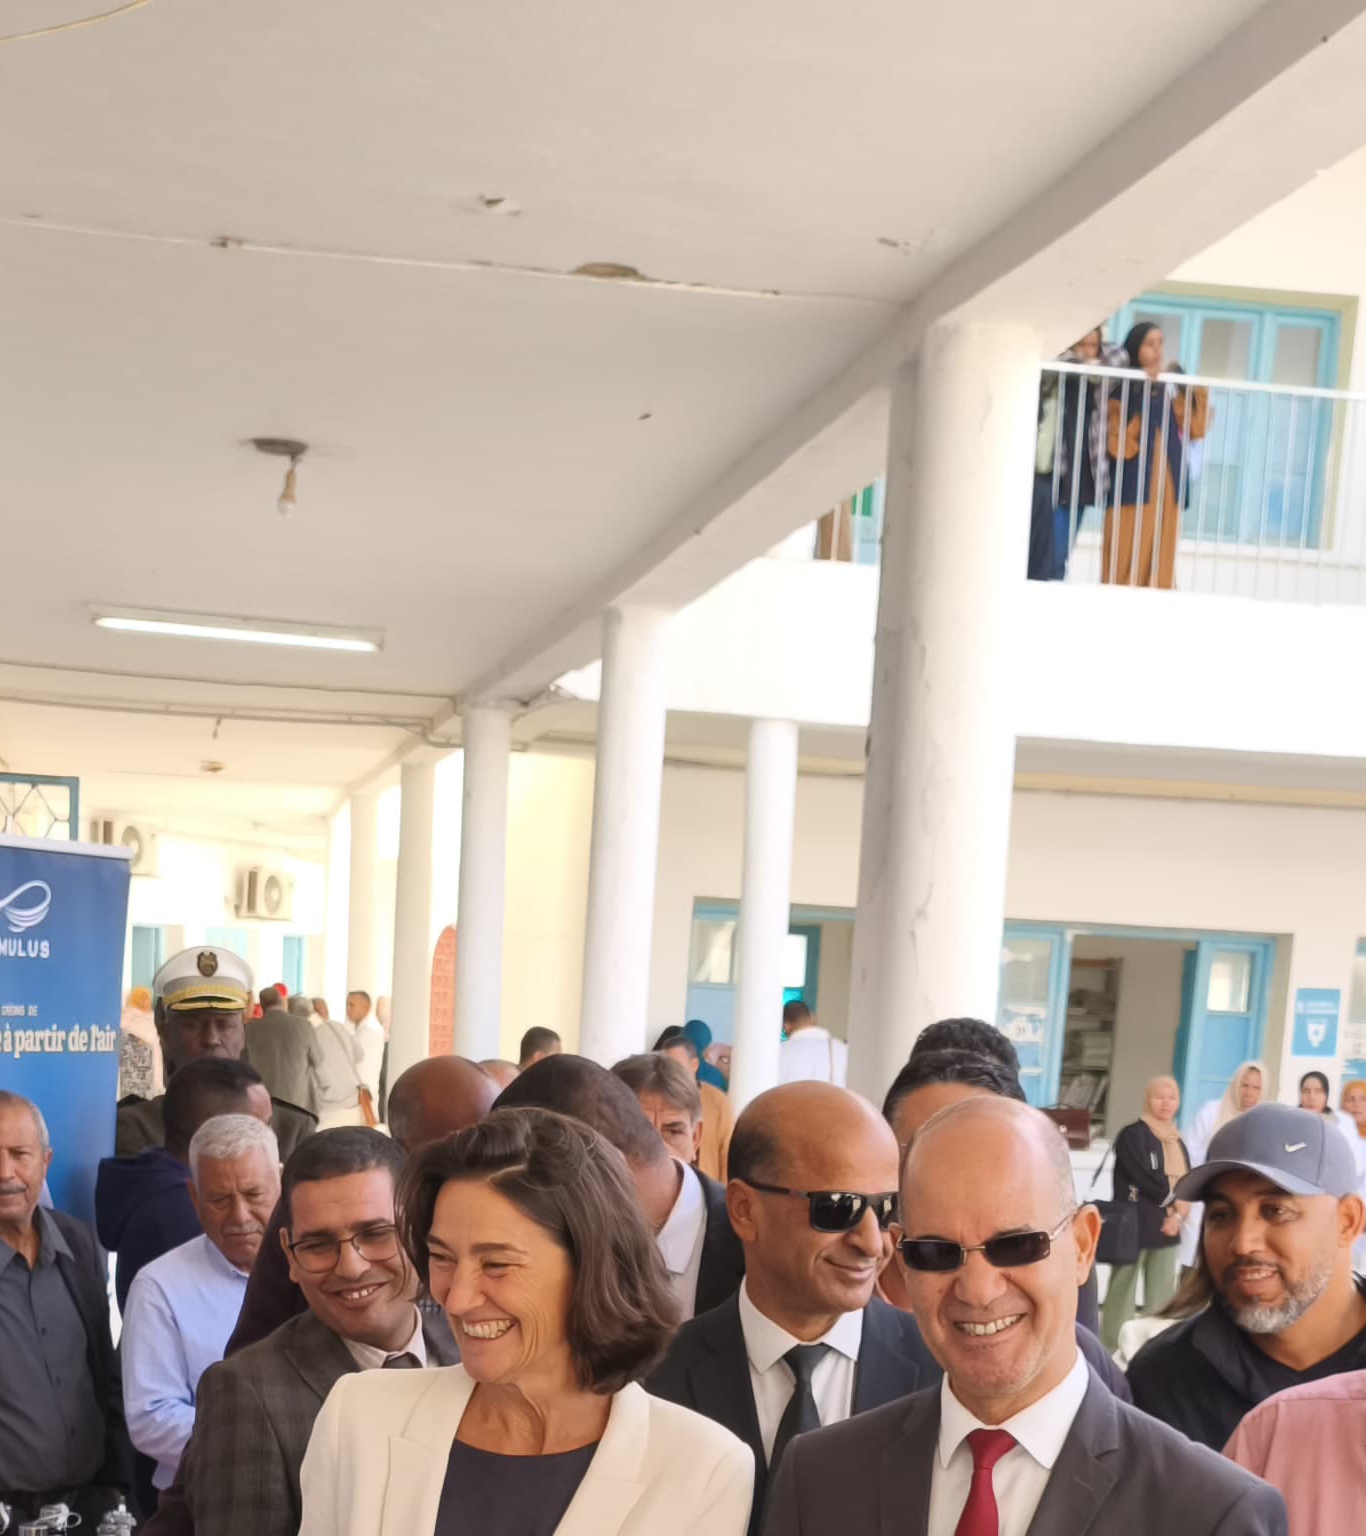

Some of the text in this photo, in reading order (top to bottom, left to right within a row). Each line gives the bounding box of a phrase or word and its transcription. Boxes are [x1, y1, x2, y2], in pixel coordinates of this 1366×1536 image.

[14, 1024, 66, 1059] partir
[68, 1024, 88, 1052] de
[90, 1024, 116, 1052] l'air
